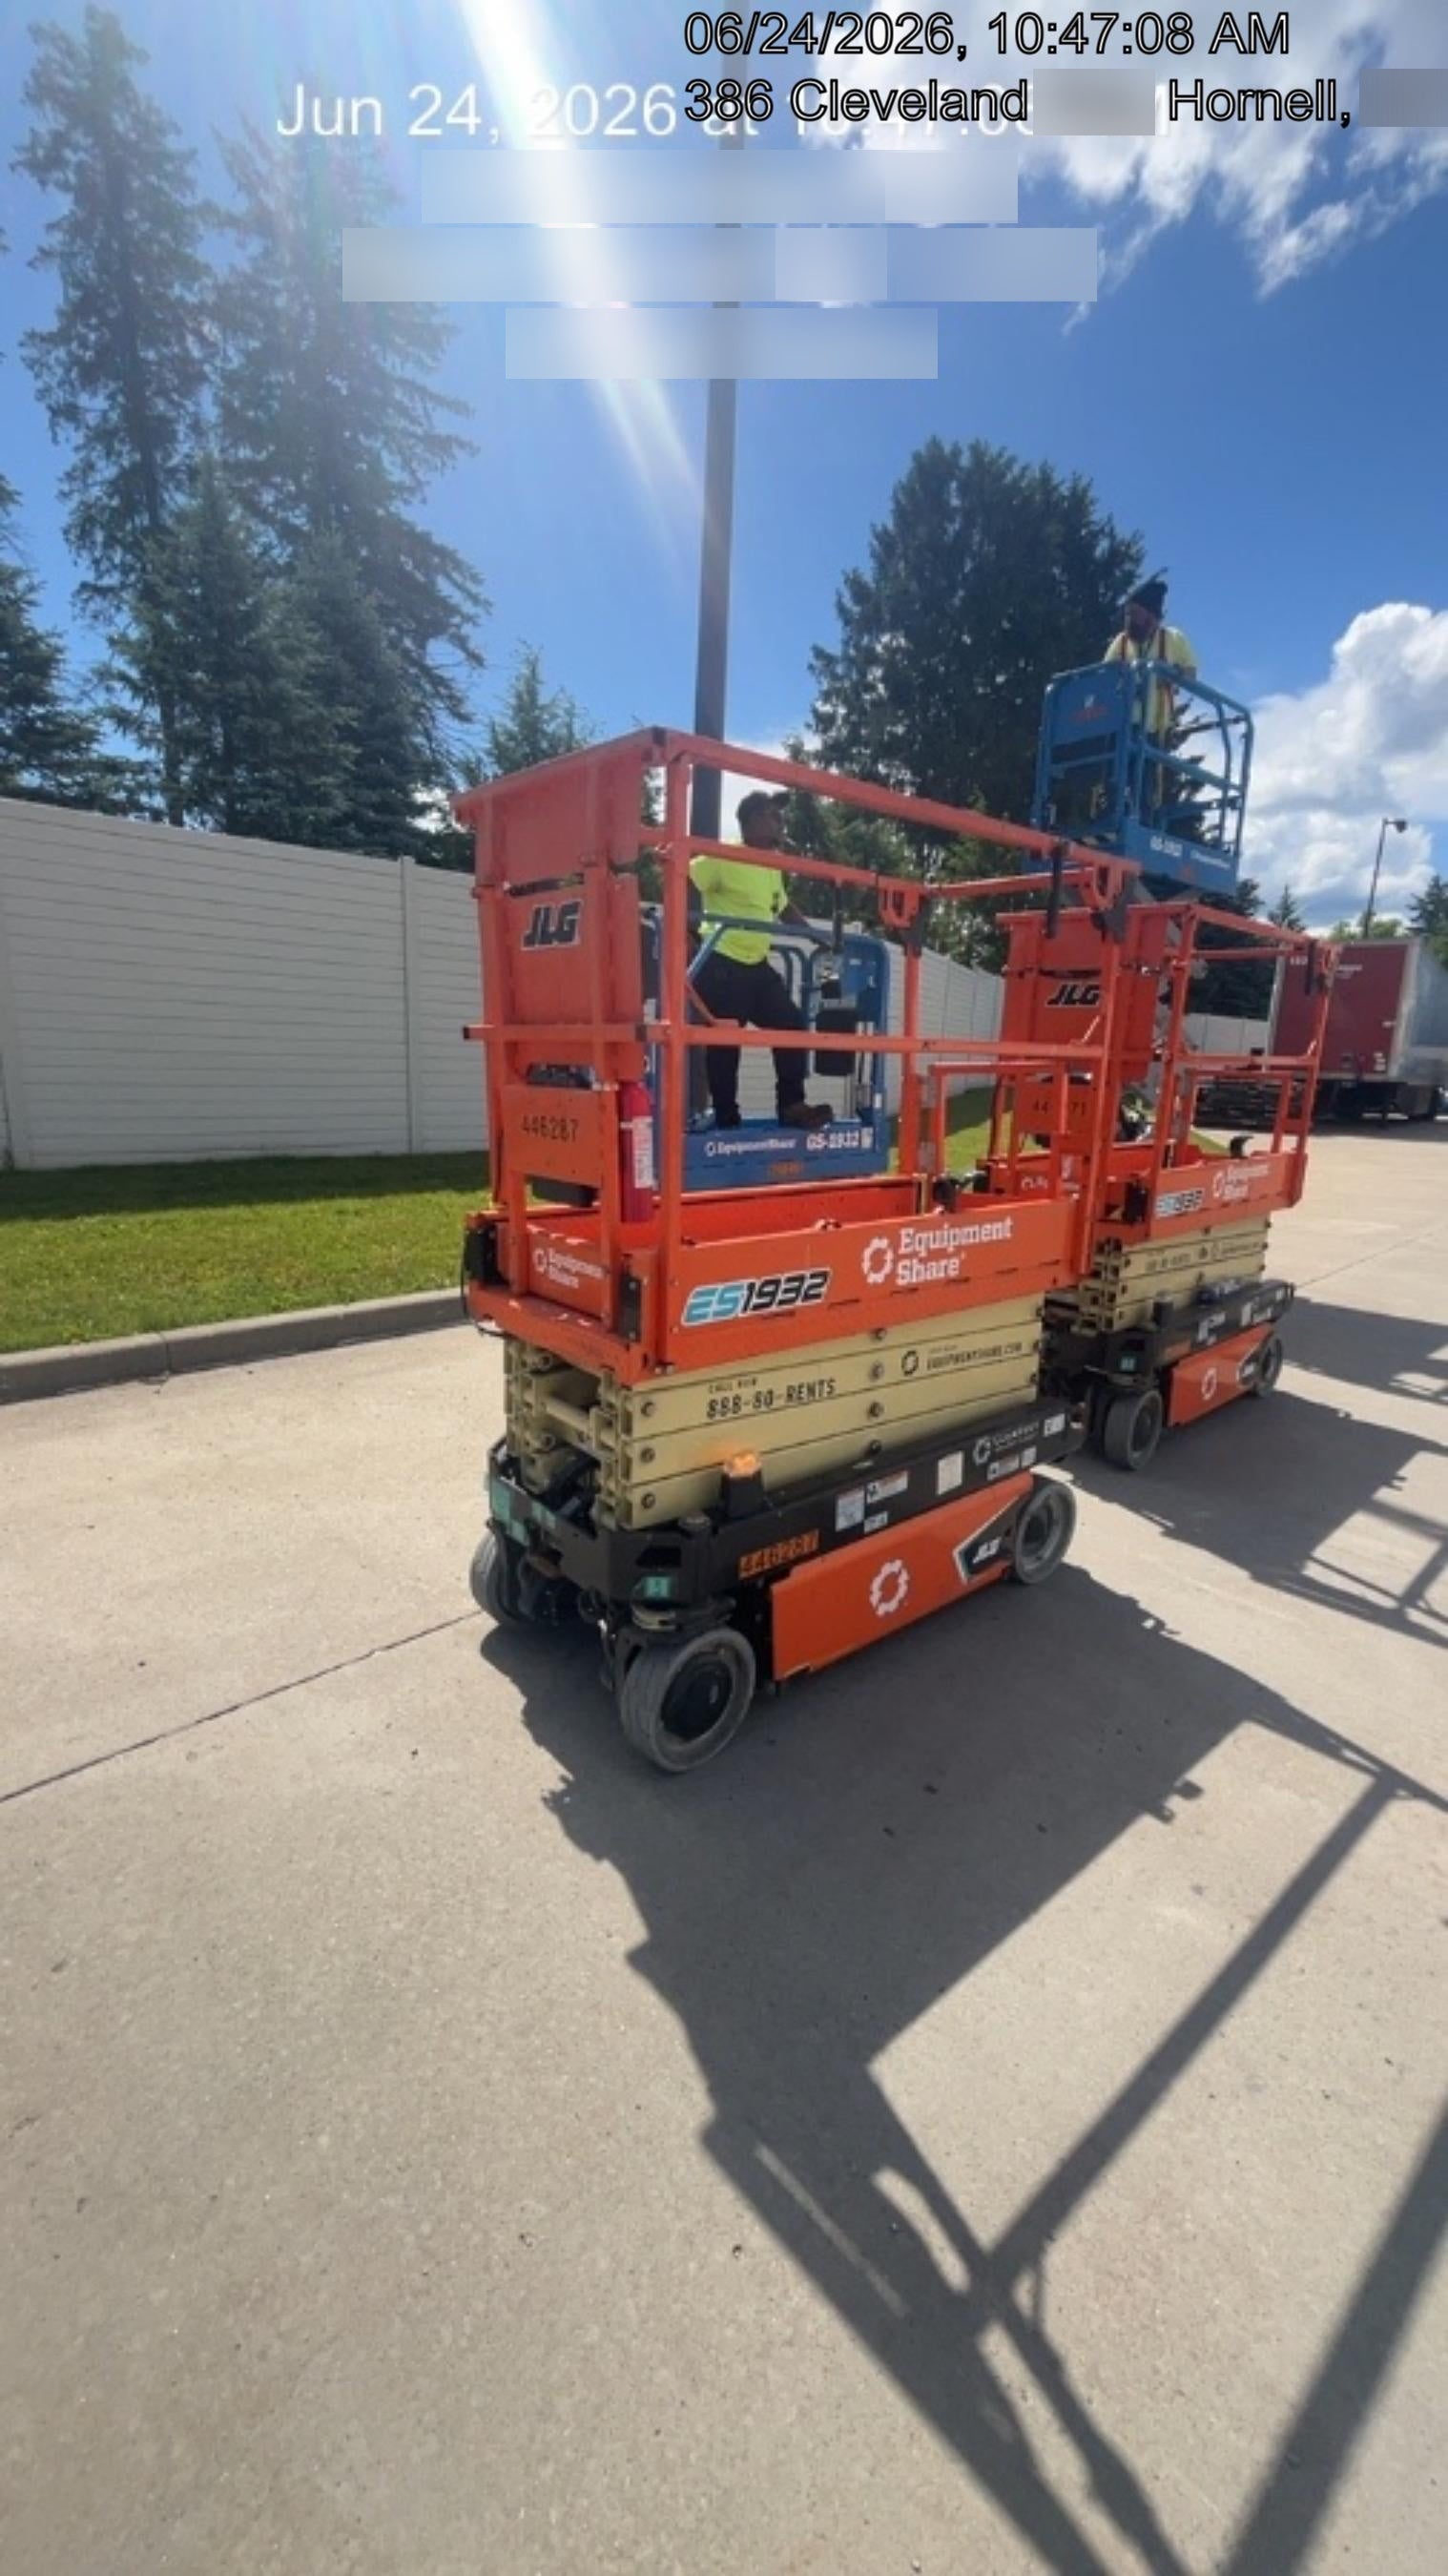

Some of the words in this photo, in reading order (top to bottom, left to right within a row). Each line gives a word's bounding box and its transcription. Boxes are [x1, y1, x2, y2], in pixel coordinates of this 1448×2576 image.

[523, 900, 583, 948] JLG
[1046, 984, 1100, 1006] JLG
[1033, 1101, 1086, 1116] 4471
[522, 1115, 579, 1142] 446287
[900, 1216, 1013, 1257] Equipment
[897, 1255, 962, 1287] Share
[682, 1267, 831, 1324] ES1932
